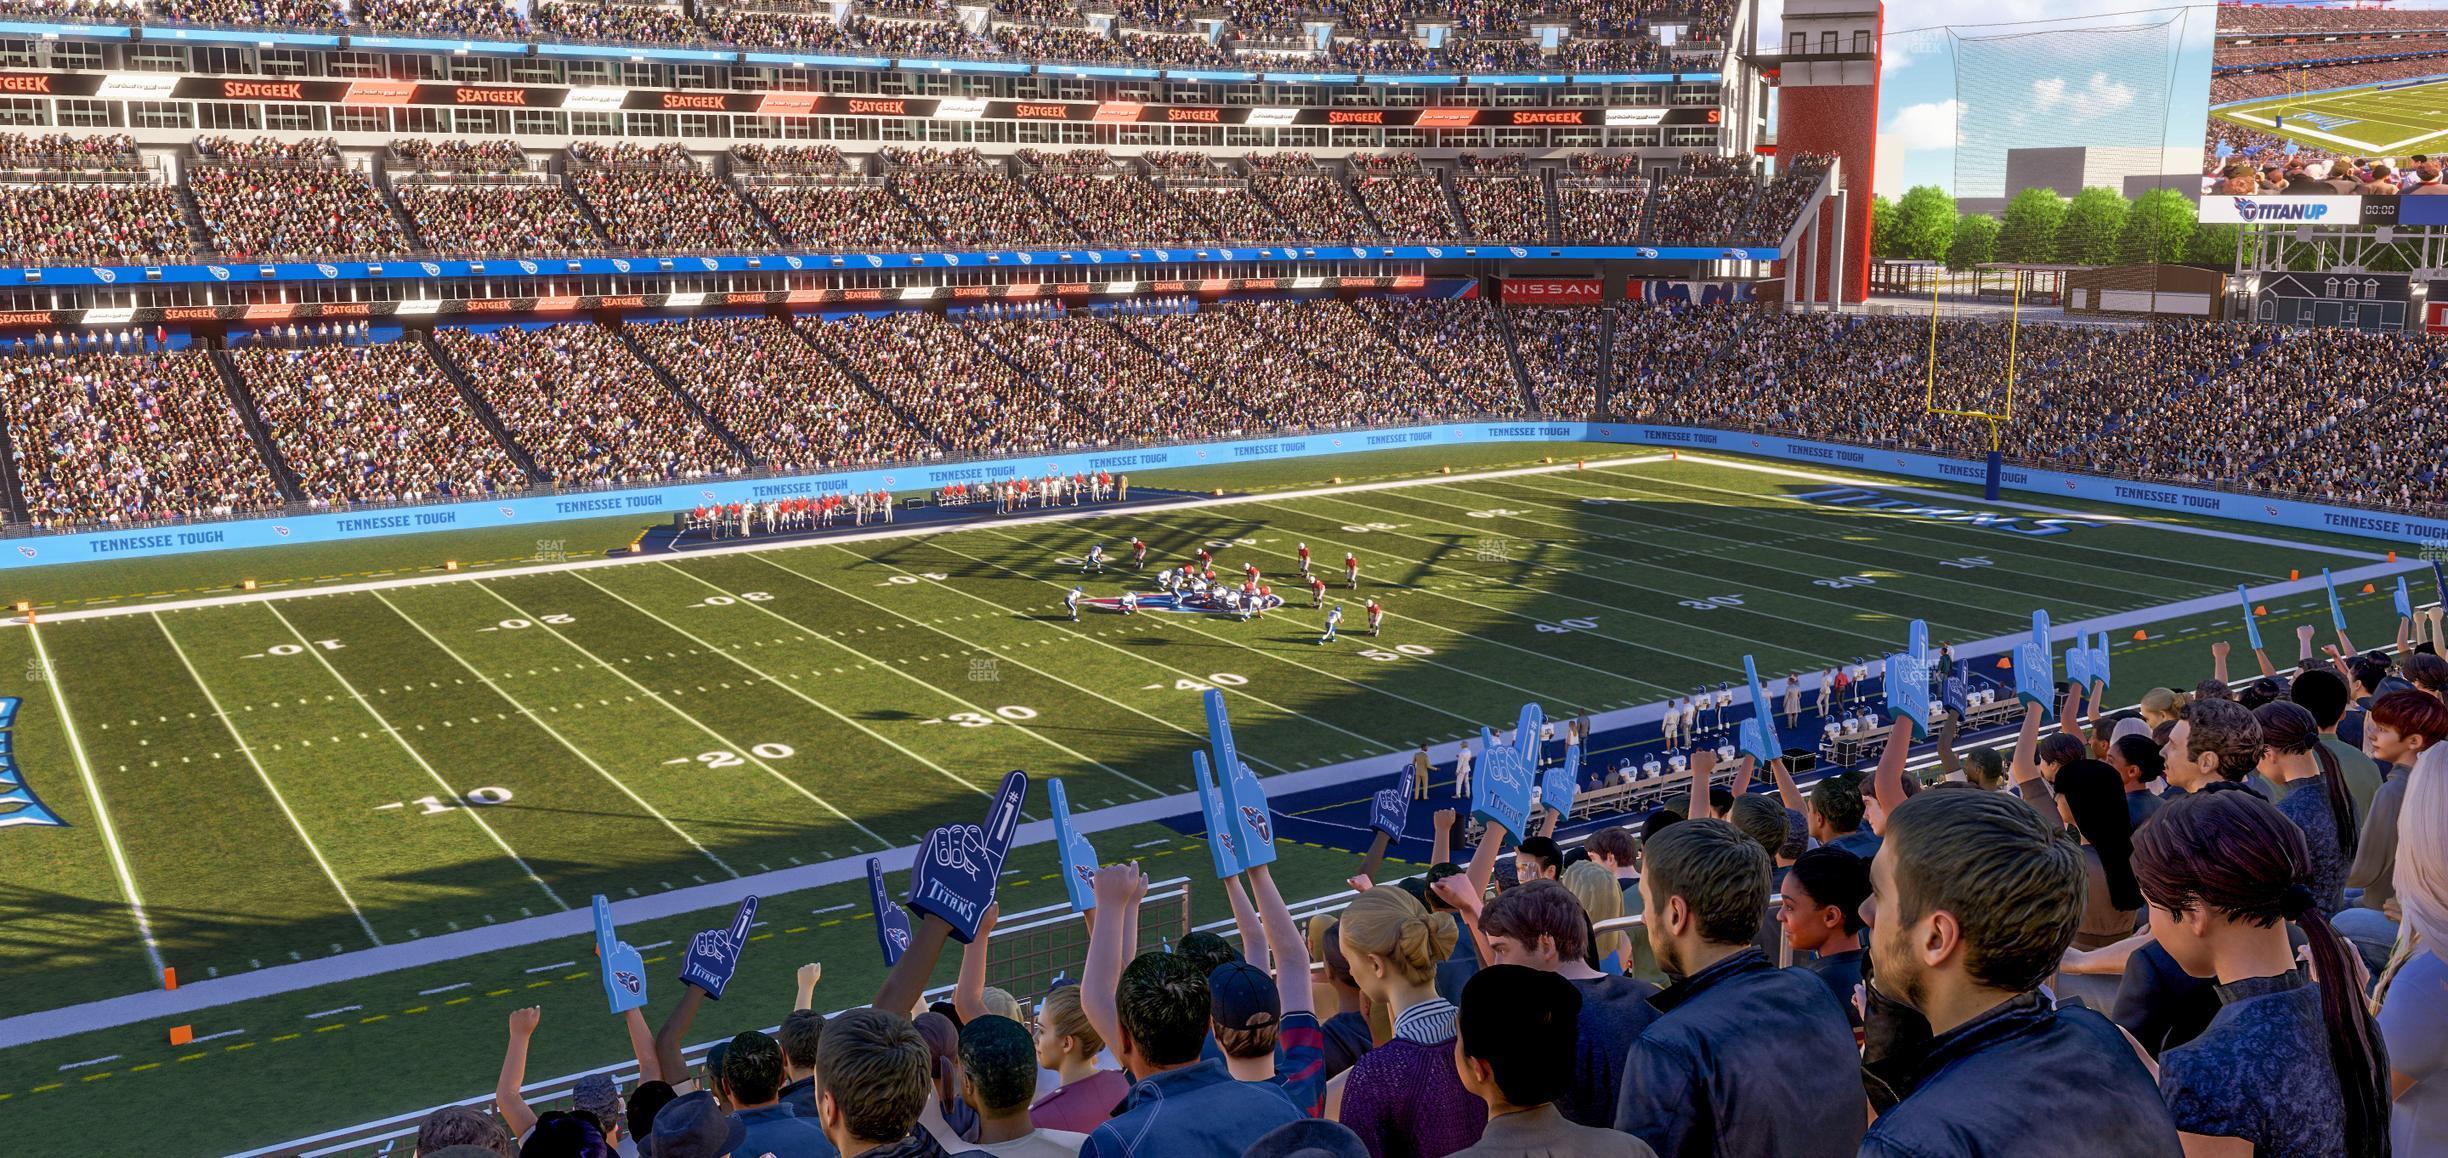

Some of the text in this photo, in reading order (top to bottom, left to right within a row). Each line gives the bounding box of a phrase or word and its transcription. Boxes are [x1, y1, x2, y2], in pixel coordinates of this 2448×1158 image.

[223, 81, 302, 99] SEATGEEK
[456, 87, 526, 105] SEATGEEK
[663, 93, 725, 109] SEATGEEK
[849, 99, 904, 115] SEATGEEK
[1016, 104, 1066, 119] SEATGEEK
[1167, 108, 1219, 122] SEATGEEK
[1328, 111, 1383, 124] SEATGEEK
[1513, 111, 1583, 125] SEATGEEK
[2364, 205, 2395, 216] 00:00
[1056, 283, 1091, 295] SEATGEEK
[1154, 280, 1186, 292] SEATGEEK
[1244, 278, 1277, 290] SEATGEEK
[1339, 276, 1377, 288] SEATGEEK
[1502, 283, 1600, 295] NISSAN
[725, 291, 768, 304] SEATGEEK
[844, 288, 882, 301] SEATGEEK
[953, 285, 990, 297] SEATGEEK
[321, 303, 370, 316] SEATGEEK
[466, 299, 513, 312] SEATGEEK
[601, 295, 645, 308] SEATGEEK
[164, 307, 218, 320] SEATGEEK
[1367, 431, 1433, 445] TENNESSEE TOUGH
[1488, 427, 1571, 437] TENNESSEE TOUGH
[1644, 430, 1718, 444] TENNESSEE TOUGH
[1234, 441, 1306, 456] TENNESSEE TOUGH
[1787, 444, 1865, 464] TENNESSEE TOUGH
[1089, 453, 1168, 469] TENNESSEE TOUGH
[929, 465, 1016, 482] TENNESSEE TOUGH
[1938, 463, 2028, 485] TENNESSE OUGH
[752, 479, 848, 497] TENNESSEE TOUGH
[556, 495, 663, 514] TENNESSEE TOUGH
[2115, 486, 2220, 510] TENNESSEE TOUGH
[337, 511, 456, 533] TENNESSEE TOUGH
[2324, 512, 2448, 540] TENNESSEE TOUGH
[90, 530, 224, 553] TENNESSEE TOUGH
[888, 572, 948, 585] 40
[1813, 576, 1876, 589] 20
[704, 591, 775, 606] 30
[1678, 595, 1744, 611] 30
[498, 613, 576, 629] 20
[1535, 617, 1599, 634] 40
[267, 639, 346, 655] 10
[1356, 644, 1434, 662] 50
[1175, 672, 1249, 692] 40
[949, 705, 1038, 727] 30
[696, 742, 795, 768] 20
[411, 786, 513, 815] 10
[1489, 790, 1522, 828] TITANS
[1379, 815, 1400, 835] TITANS
[927, 877, 978, 923] TITANS
[690, 962, 723, 989] TITANS
